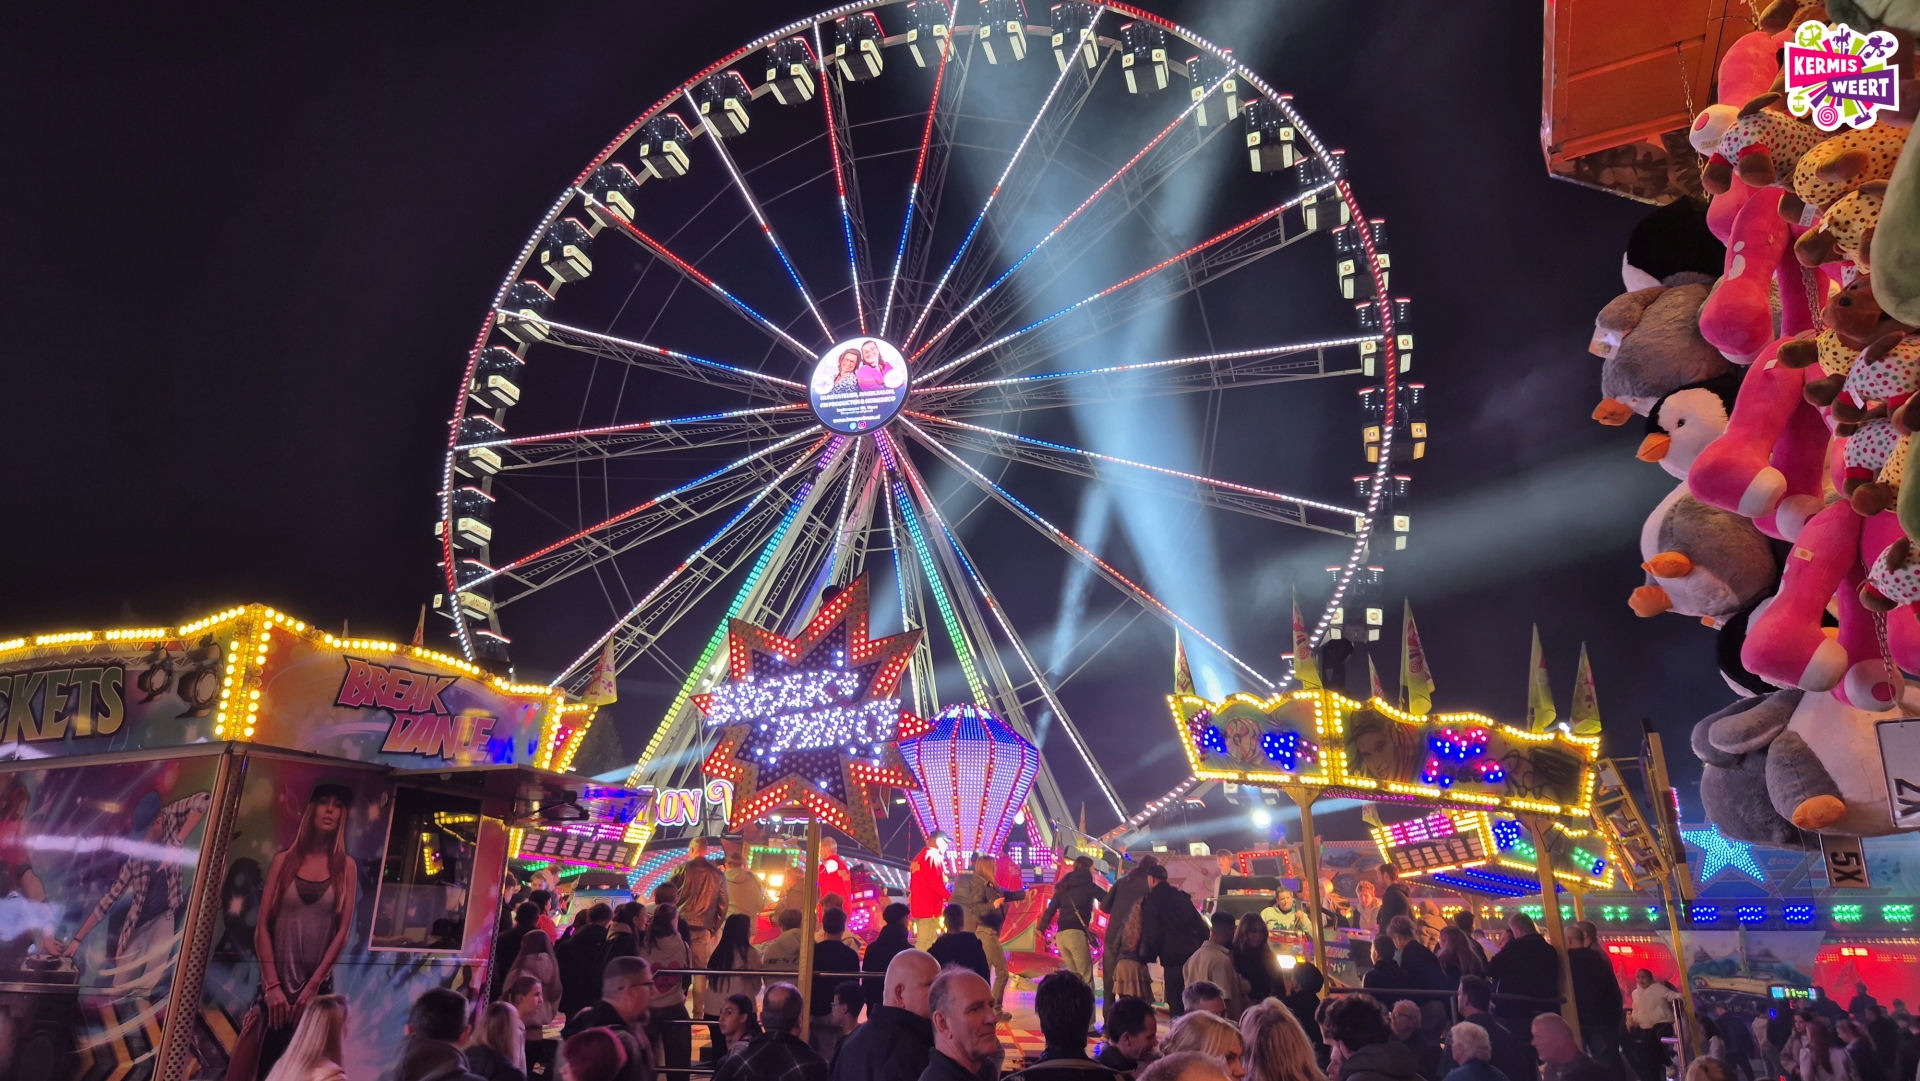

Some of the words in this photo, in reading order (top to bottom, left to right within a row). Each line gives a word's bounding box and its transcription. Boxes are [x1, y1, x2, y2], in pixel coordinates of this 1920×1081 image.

[337, 658, 459, 714] BREAK
[381, 713, 497, 762] DANCE
[1830, 851, 1864, 883] 5X
